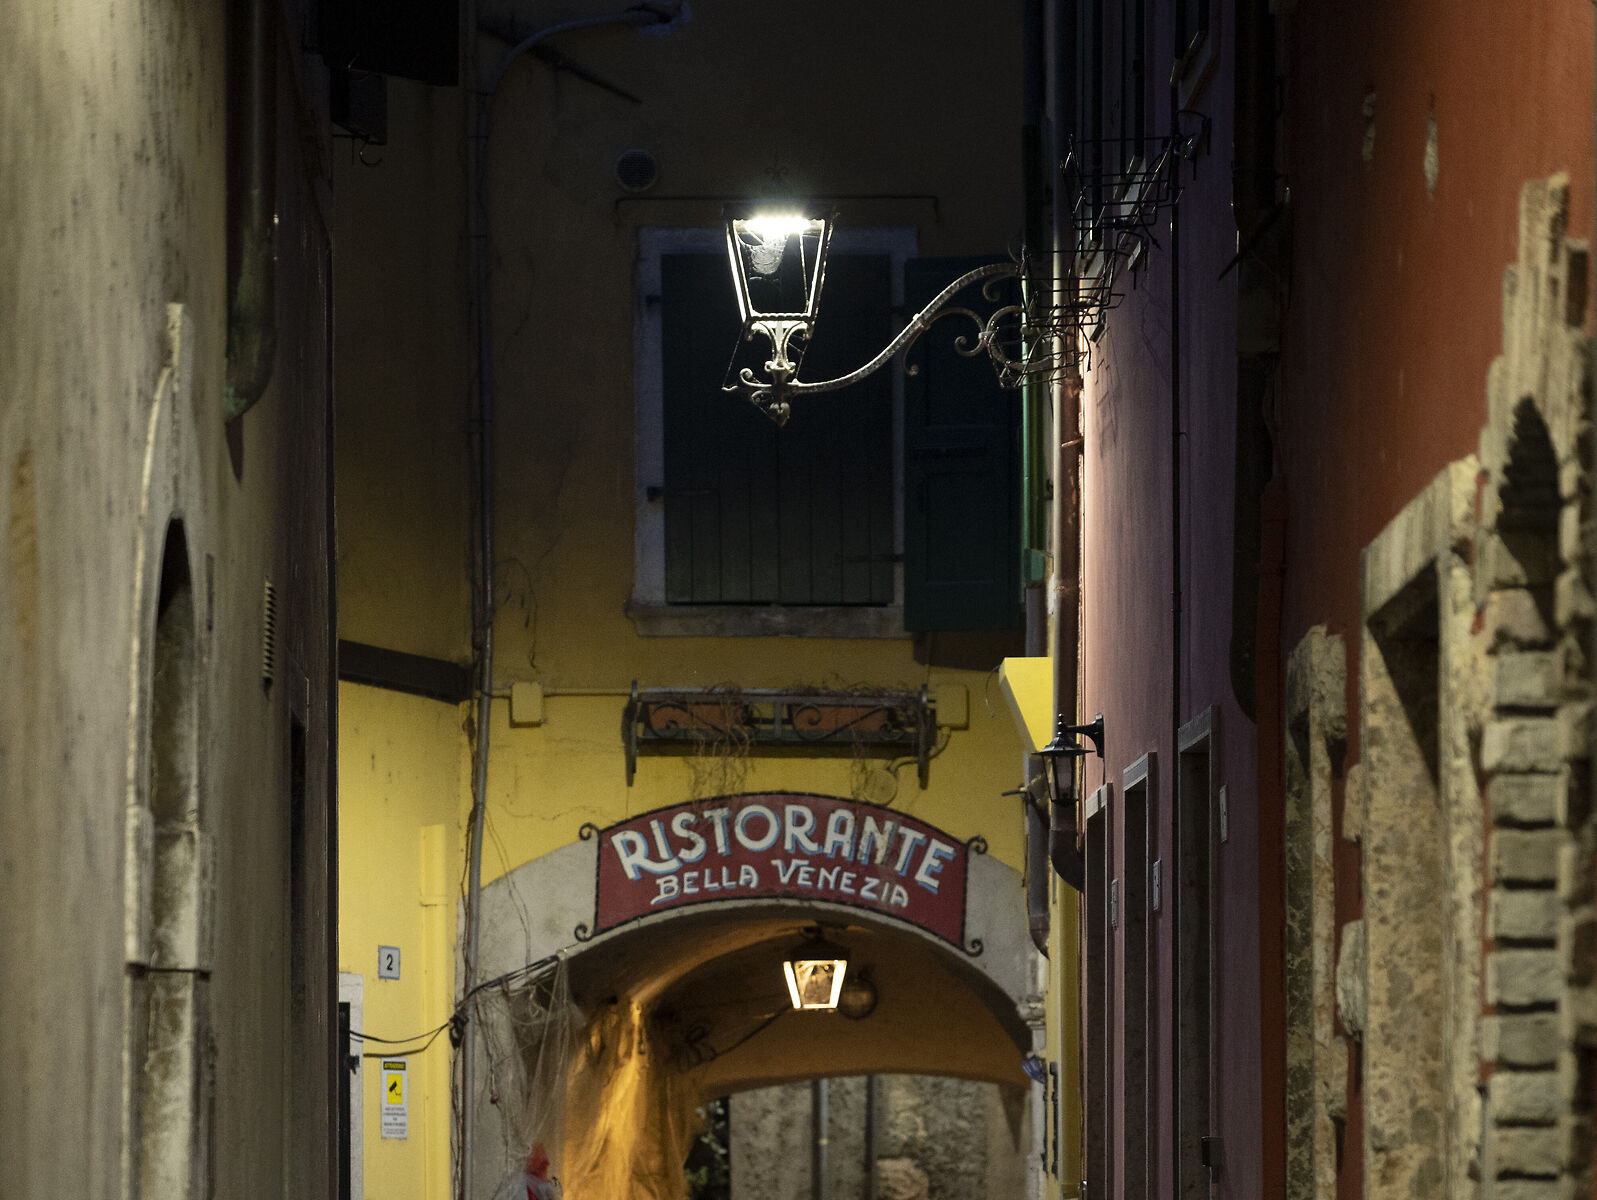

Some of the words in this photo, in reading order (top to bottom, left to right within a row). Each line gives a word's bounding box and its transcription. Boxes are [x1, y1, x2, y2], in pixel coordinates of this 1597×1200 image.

[611, 804, 956, 893] RISTORANTE
[649, 865, 760, 906] BELLA
[771, 859, 909, 909] VENEZIA
[386, 954, 393, 970] 2
